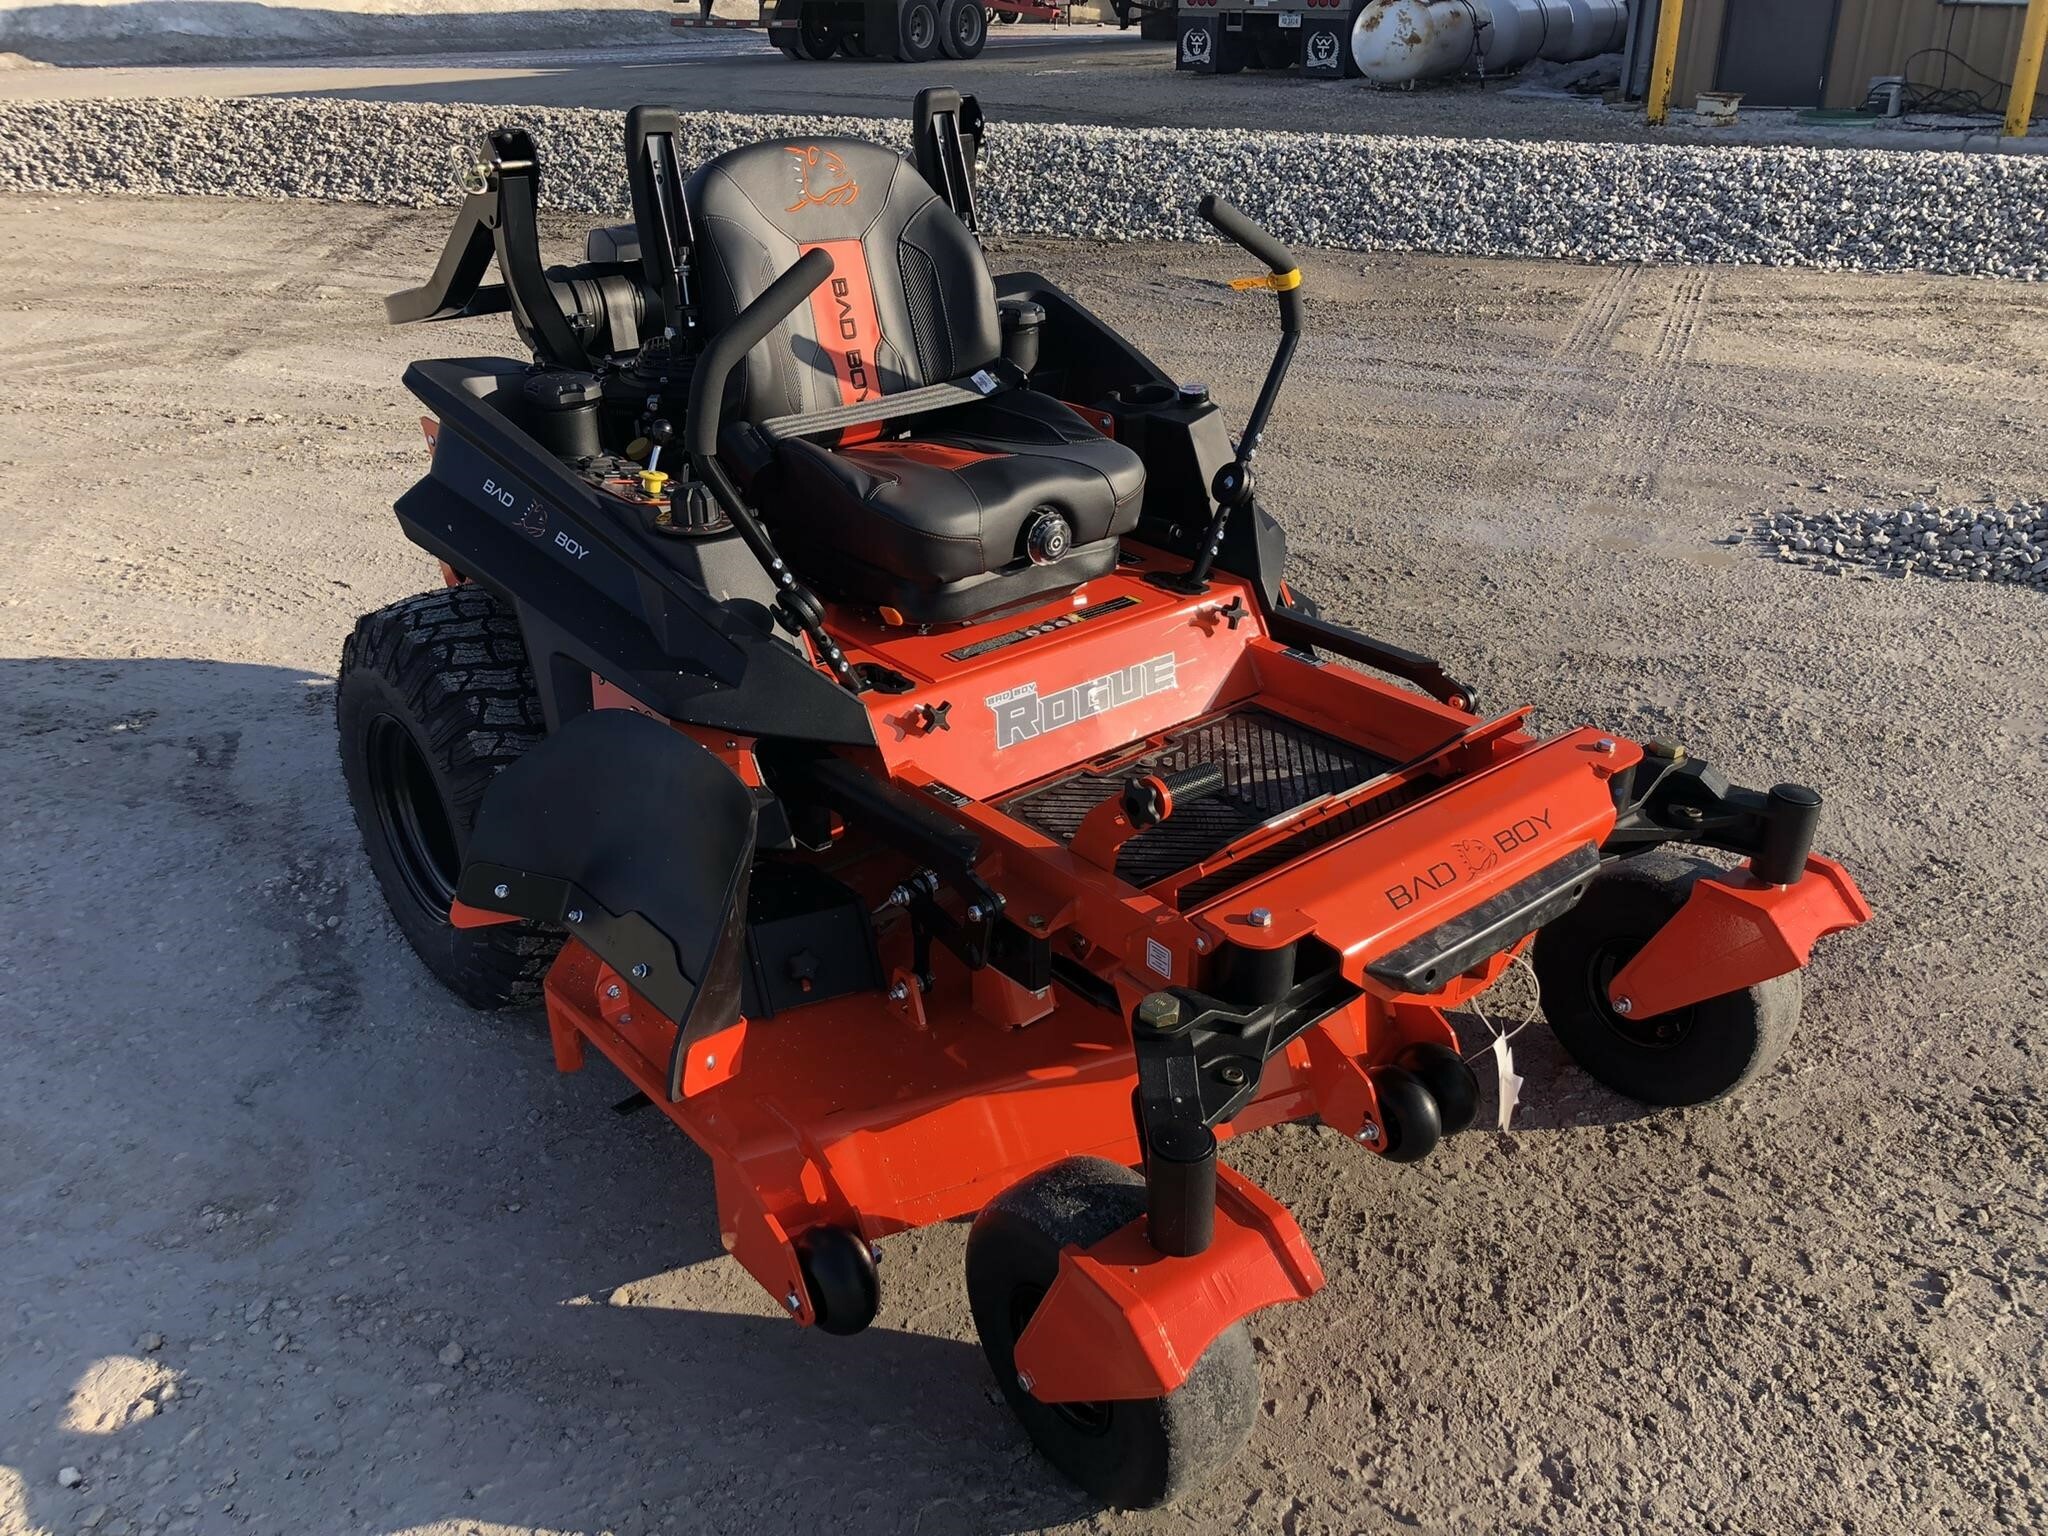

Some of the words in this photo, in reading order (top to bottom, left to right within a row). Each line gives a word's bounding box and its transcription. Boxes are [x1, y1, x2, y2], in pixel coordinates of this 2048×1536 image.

[831, 278, 857, 340] BAD
[483, 479, 515, 507] BAD
[555, 531, 590, 560] BOY
[987, 692, 1010, 705] BAD
[1013, 684, 1035, 696] BOY
[990, 651, 1176, 749] ROGUE
[1384, 862, 1457, 910] BAD
[1493, 808, 1552, 853] BOY
